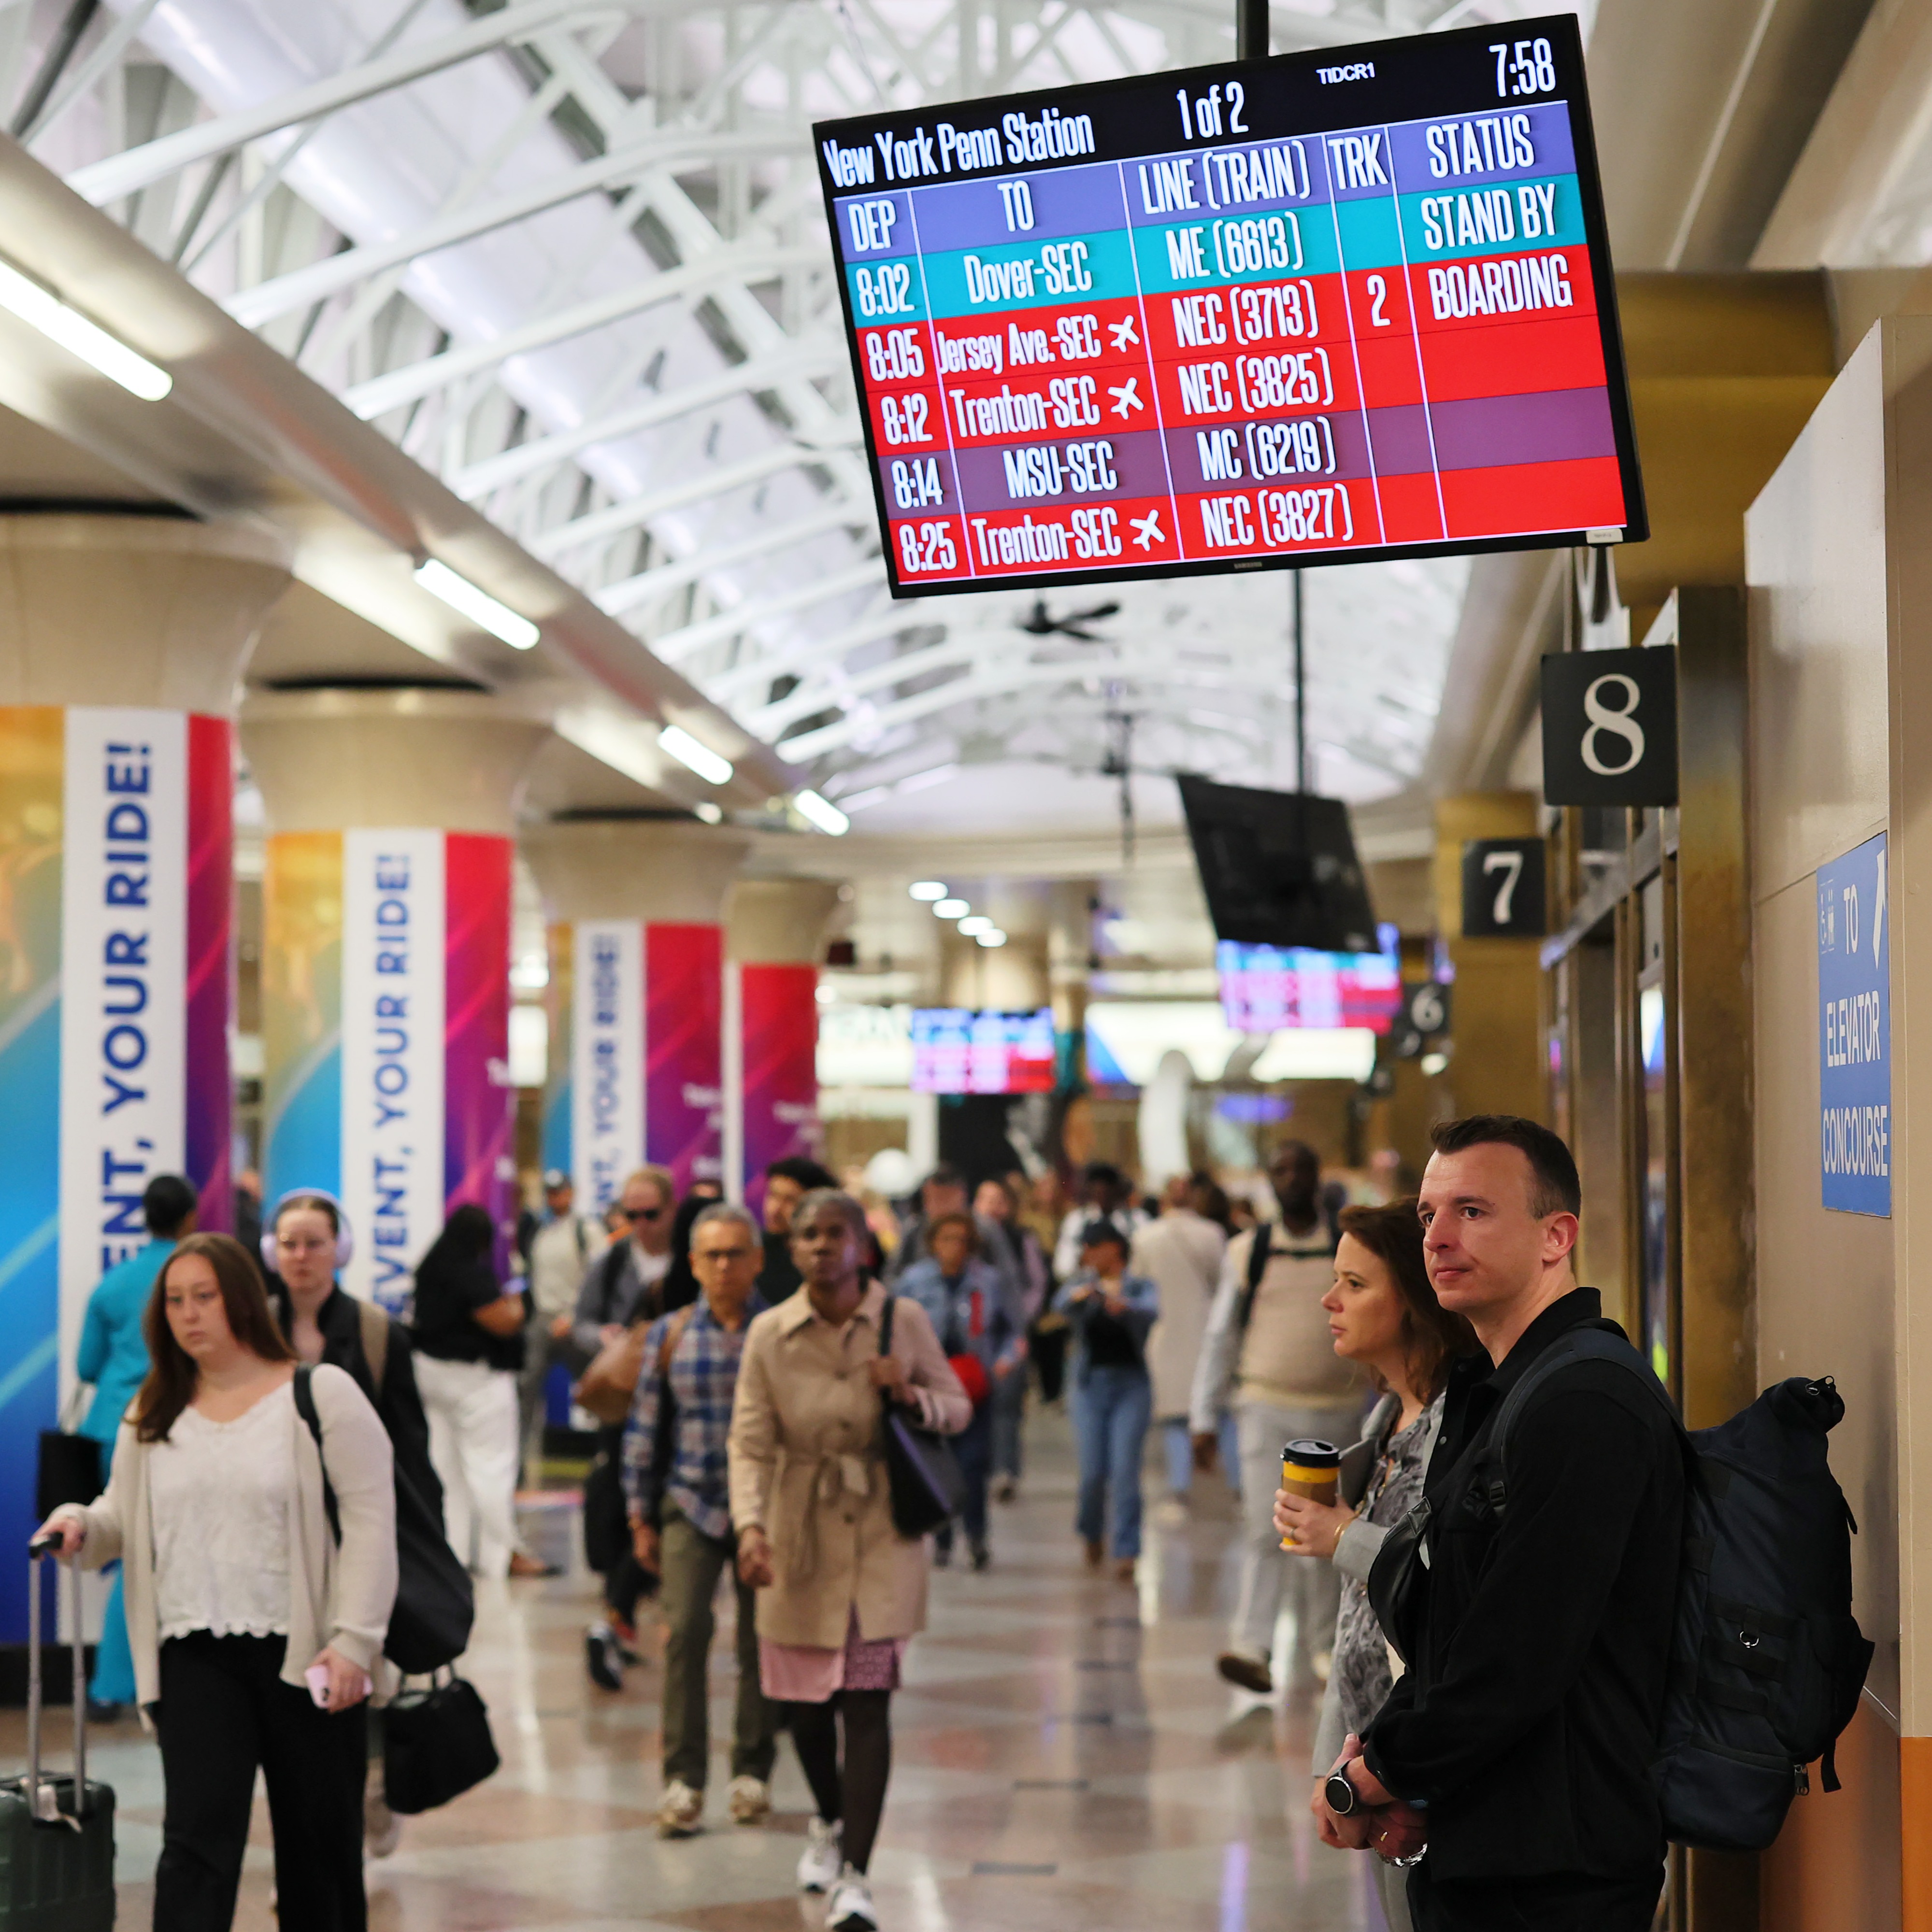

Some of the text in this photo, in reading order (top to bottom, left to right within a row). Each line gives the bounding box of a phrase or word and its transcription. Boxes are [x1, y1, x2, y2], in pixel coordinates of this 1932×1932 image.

[1176, 81, 1249, 140] 1 of 2
[1489, 38, 1556, 98] 7:58
[847, 113, 1534, 253] DEP TO LINE (TRAIN) TRK STATUS
[874, 127, 939, 181] York
[937, 123, 1003, 173] Penn
[1002, 107, 1096, 164] Station
[856, 183, 1555, 317] 8:02 Dover-SEC ME (6613) STAND BY
[865, 254, 1574, 382] 8:05 Jersey Ave.-SEC NEC (3713) 2 BOARDING
[880, 346, 1334, 445] 8:12 Trenton-SEC NEC (3825)
[891, 415, 1336, 510] 8:14 MSU-SEC MC (6219)
[899, 483, 1354, 573] 8:25 Trenton-SEC NEC (3827)
[1581, 673, 1645, 776] 8
[105, 742, 153, 908] RIDE!
[374, 853, 410, 975] RIDE!
[1483, 851, 1523, 924] 7
[1843, 883, 1859, 955] TO
[103, 930, 149, 1116] YOUR
[1411, 985, 1445, 1032] 6
[1826, 990, 1881, 1067] ELEVATOR
[374, 993, 409, 1128] YOUR
[1822, 1105, 1888, 1177] CONCOURSE
